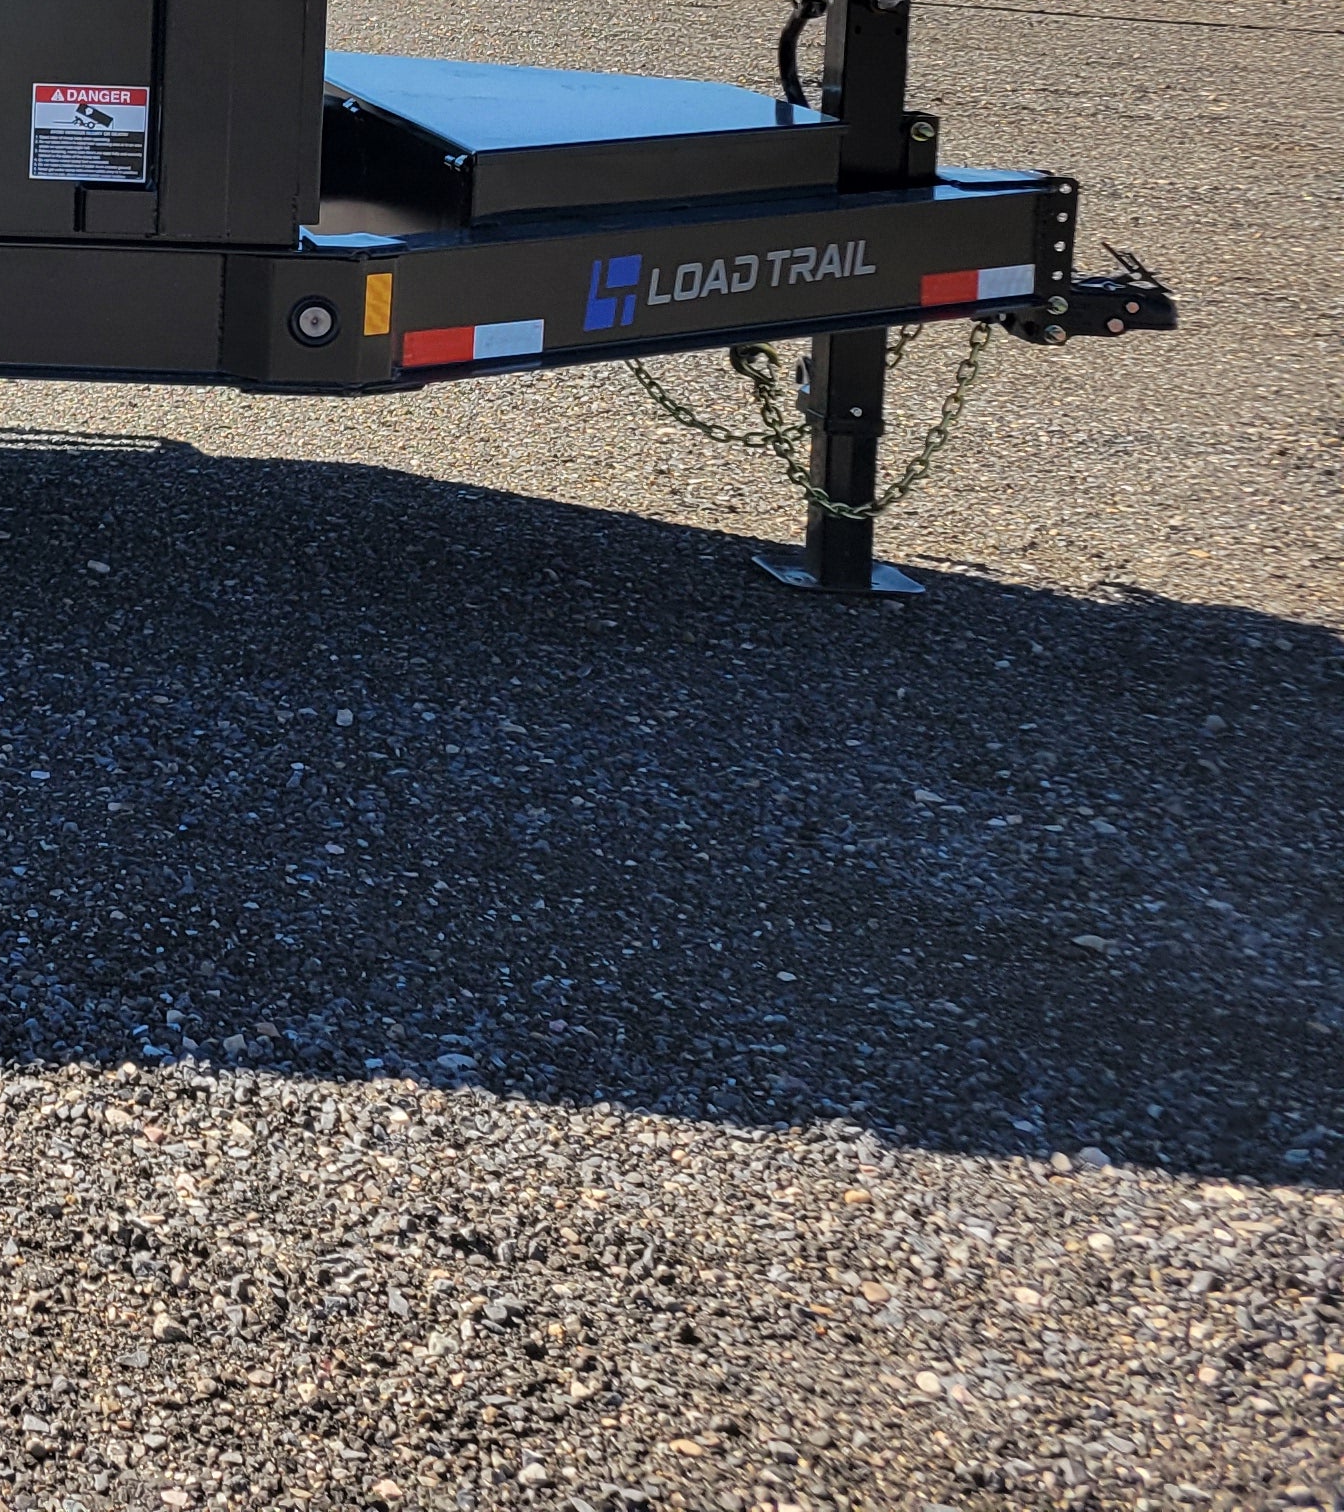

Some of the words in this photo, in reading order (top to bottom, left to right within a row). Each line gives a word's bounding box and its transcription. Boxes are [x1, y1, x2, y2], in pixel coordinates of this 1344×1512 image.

[66, 89, 131, 104] DANGER
[647, 254, 759, 306] LOAD
[766, 240, 877, 287] TRAIL
